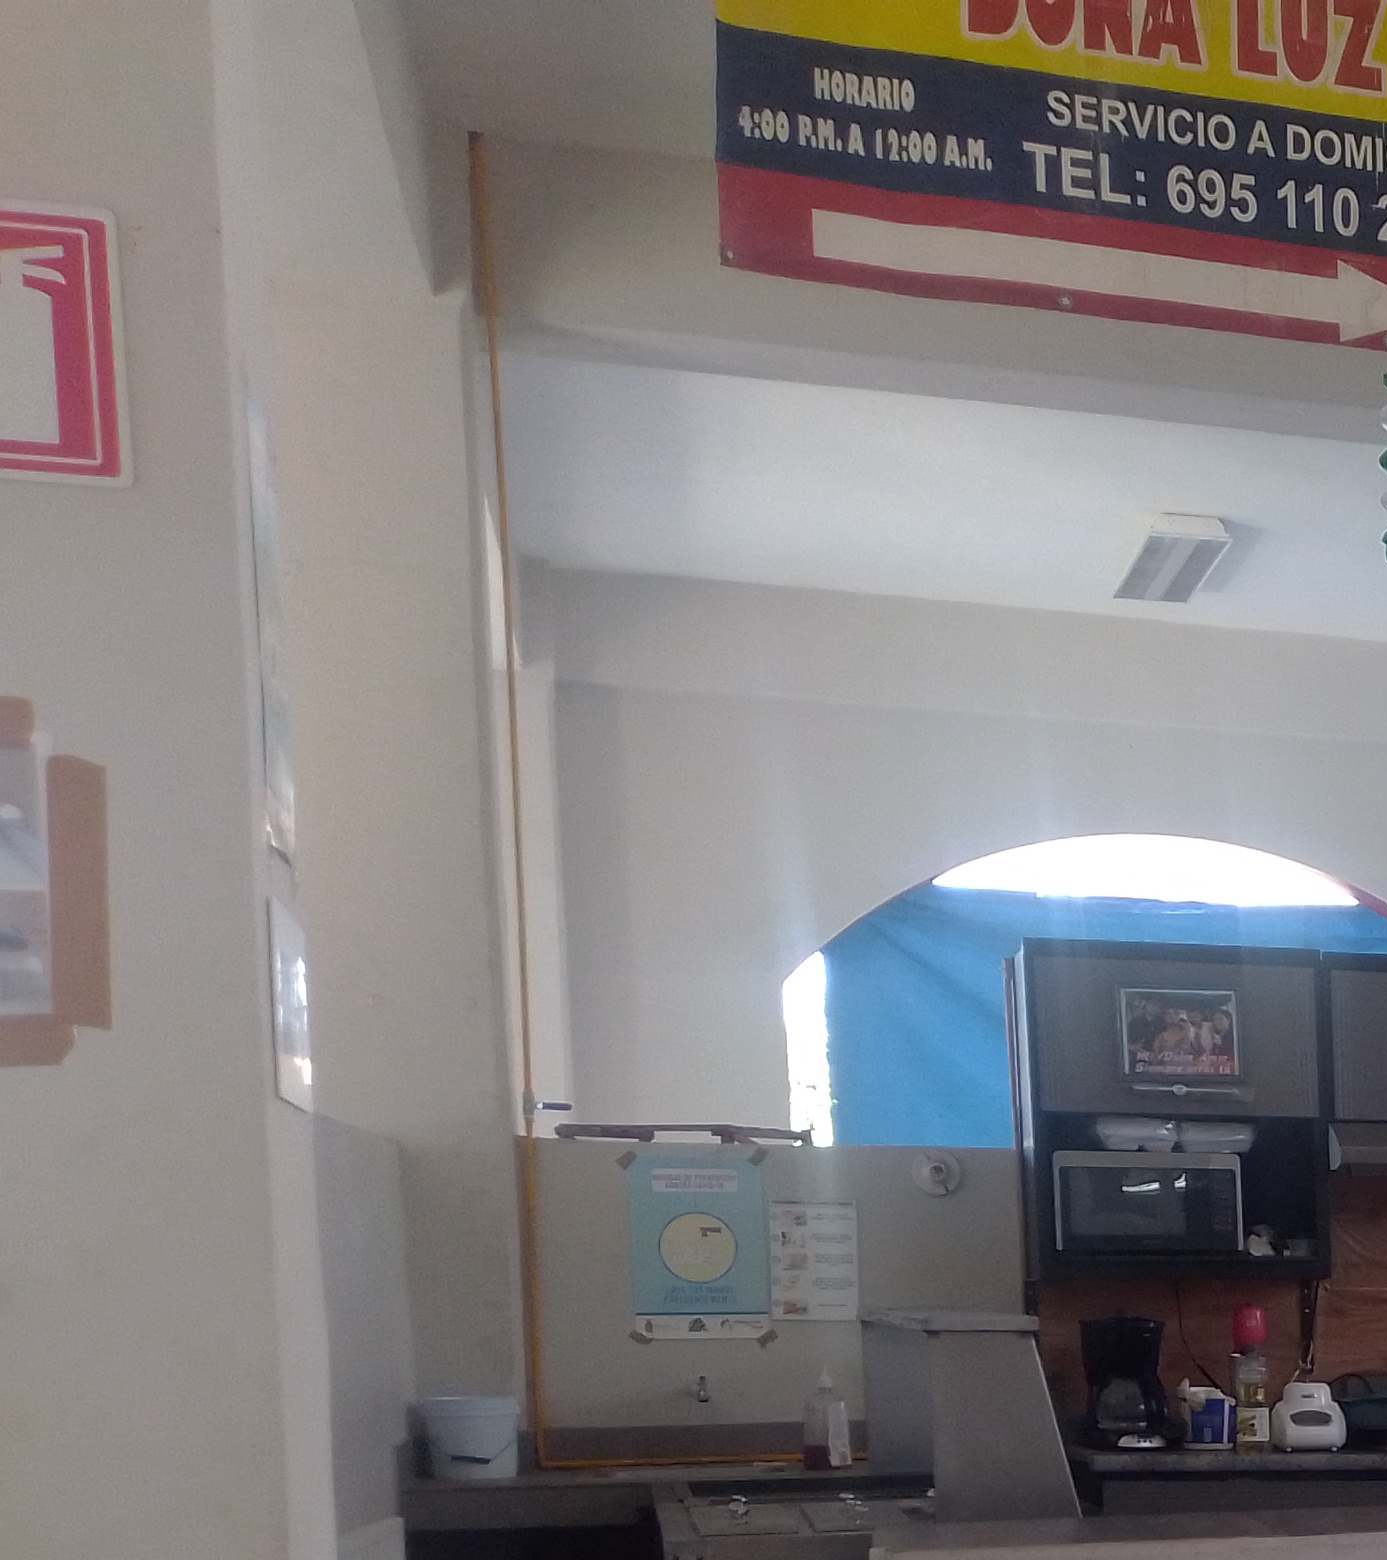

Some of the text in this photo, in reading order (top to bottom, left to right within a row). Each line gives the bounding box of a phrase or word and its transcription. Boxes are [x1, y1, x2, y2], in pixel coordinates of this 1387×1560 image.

[1235, 0, 1385, 92] LUZ
[813, 66, 916, 113] HORARIO
[738, 104, 993, 172] 4:00 P.M. A 12:00 A.M.
[1046, 91, 1236, 151] SERVICIO
[1247, 120, 1276, 159] A
[1022, 140, 1147, 207] TEL:
[1166, 165, 1258, 224] 695
[1277, 179, 1360, 237] 110
